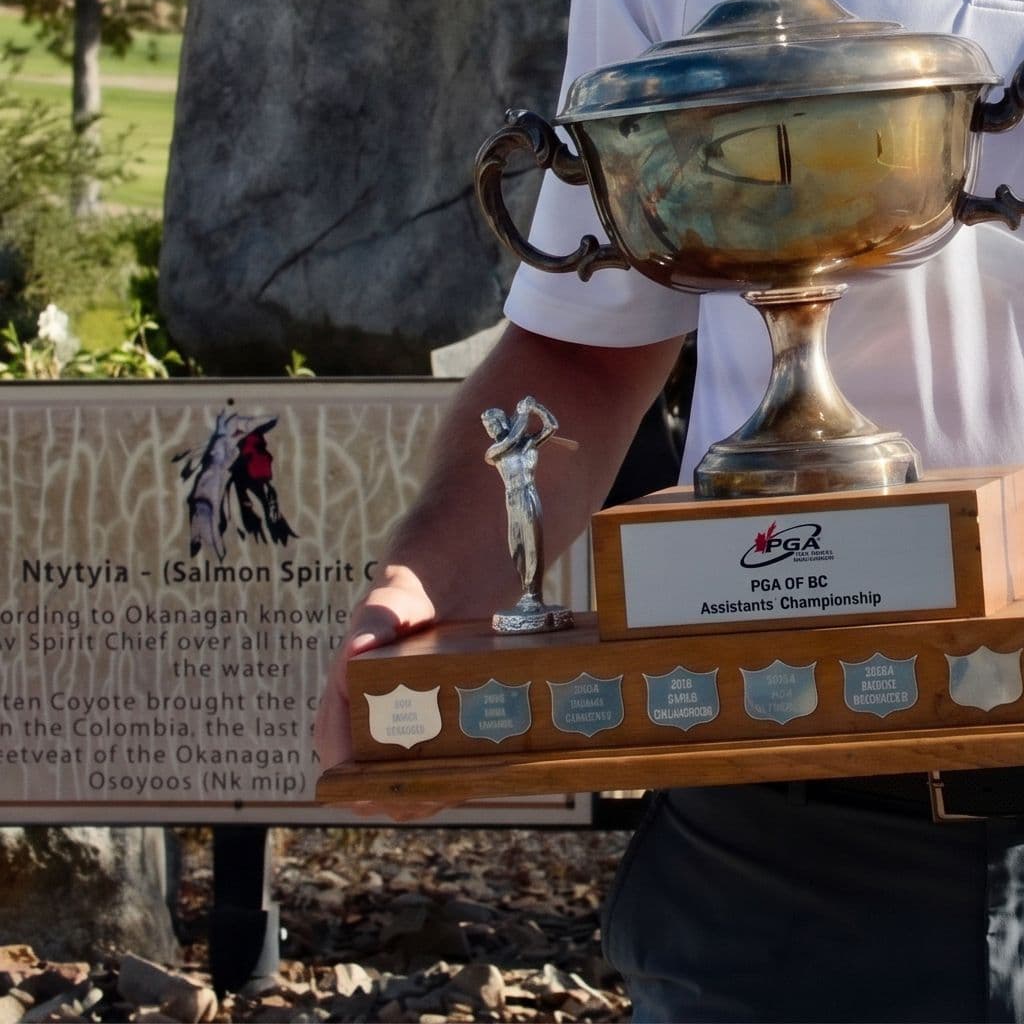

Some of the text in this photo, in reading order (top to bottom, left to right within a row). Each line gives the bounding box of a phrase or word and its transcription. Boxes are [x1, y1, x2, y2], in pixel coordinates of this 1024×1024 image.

[765, 537, 820, 552] PGA
[163, 559, 271, 585] (Salmon
[280, 560, 354, 588] Spirit
[751, 575, 828, 593] PGA OF BC
[780, 590, 882, 611] Championship
[0, 603, 349, 630] ording to Okanagan knowle
[104, 631, 168, 651] Chief
[177, 636, 232, 651] over
[241, 631, 269, 651] all
[279, 631, 319, 651] the
[173, 658, 291, 677] the water
[3, 693, 42, 711] ten
[50, 692, 137, 715] Coyote
[147, 691, 245, 715] brought
[256, 692, 296, 711] the
[24, 717, 63, 737] the
[206, 717, 245, 737] the
[256, 716, 299, 737] last
[93, 743, 118, 764] of
[126, 743, 166, 764] the
[175, 743, 300, 769] Okanagan
[88, 770, 193, 795] Osoyoos
